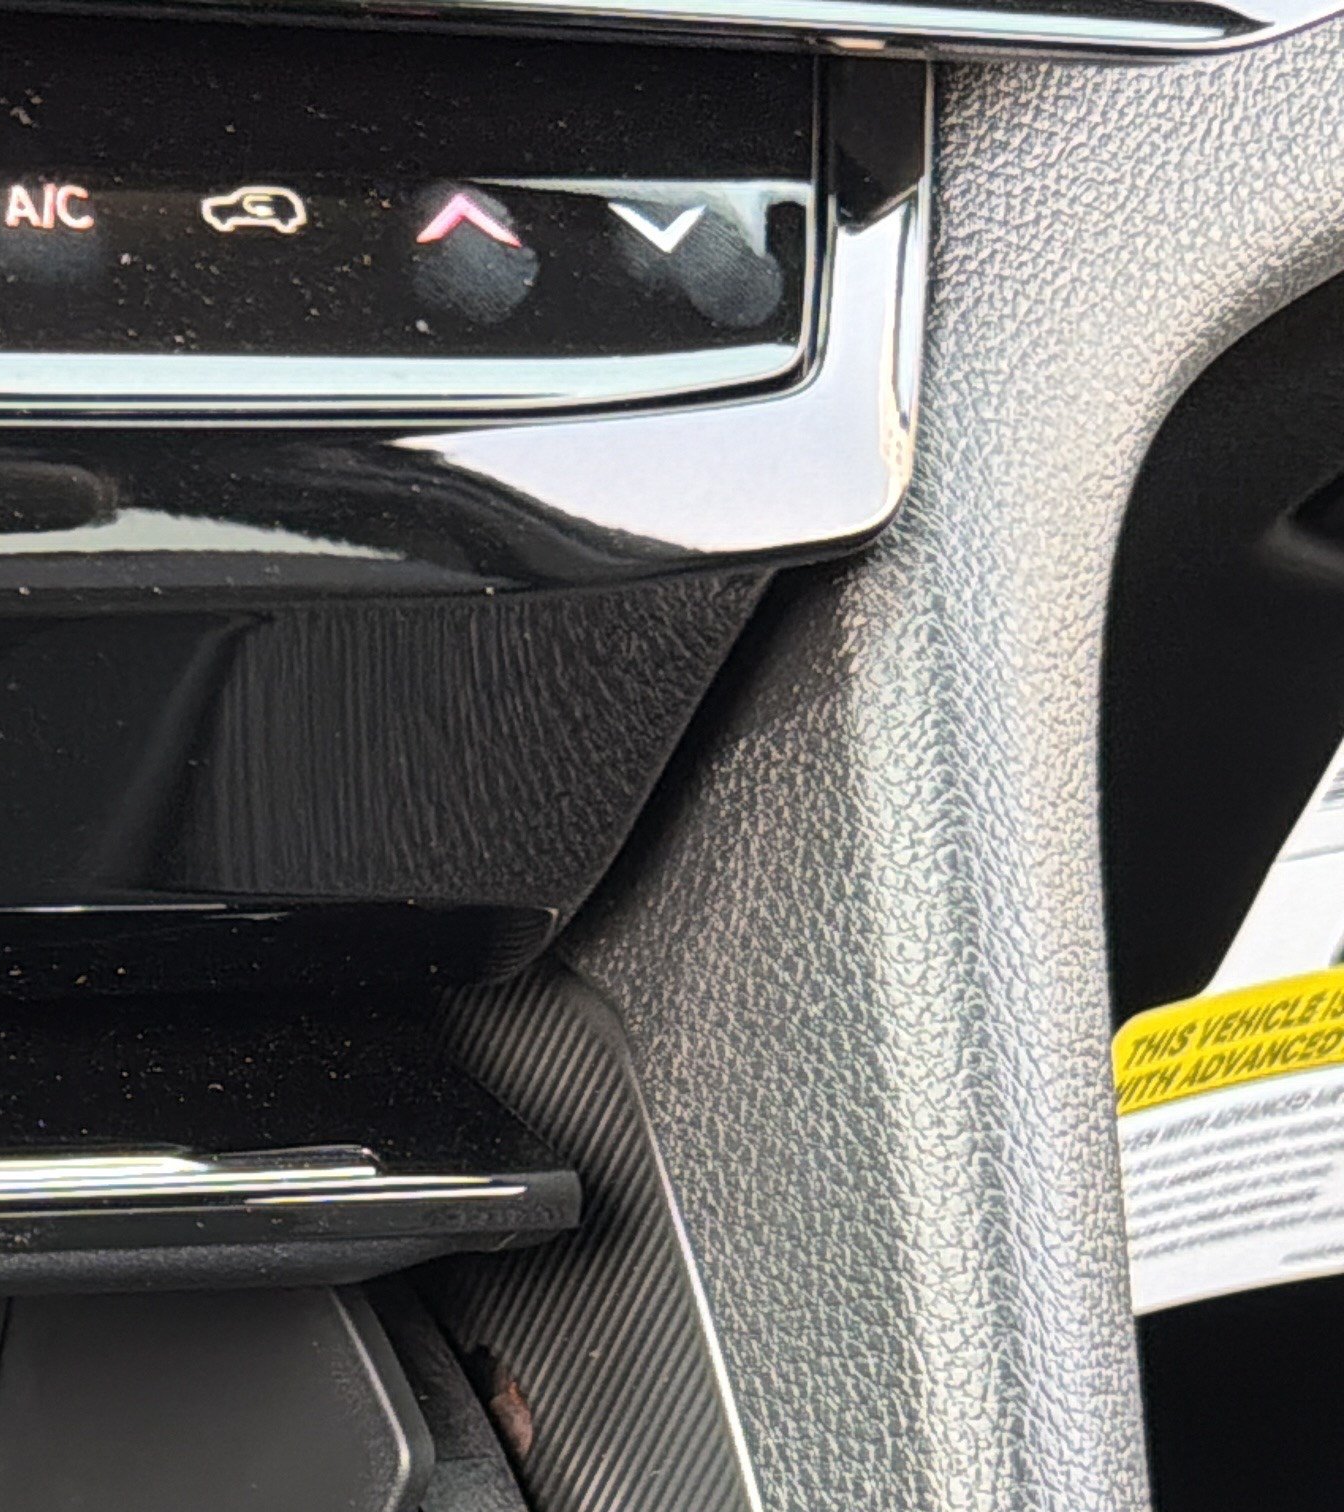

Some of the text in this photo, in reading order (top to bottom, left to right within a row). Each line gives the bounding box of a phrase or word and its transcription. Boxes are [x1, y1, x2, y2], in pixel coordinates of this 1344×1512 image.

[4, 182, 95, 230] A/C
[1123, 1019, 1198, 1071] THIS
[1196, 989, 1328, 1050] VEHICLE
[1175, 1026, 1344, 1091] ADVANCED
